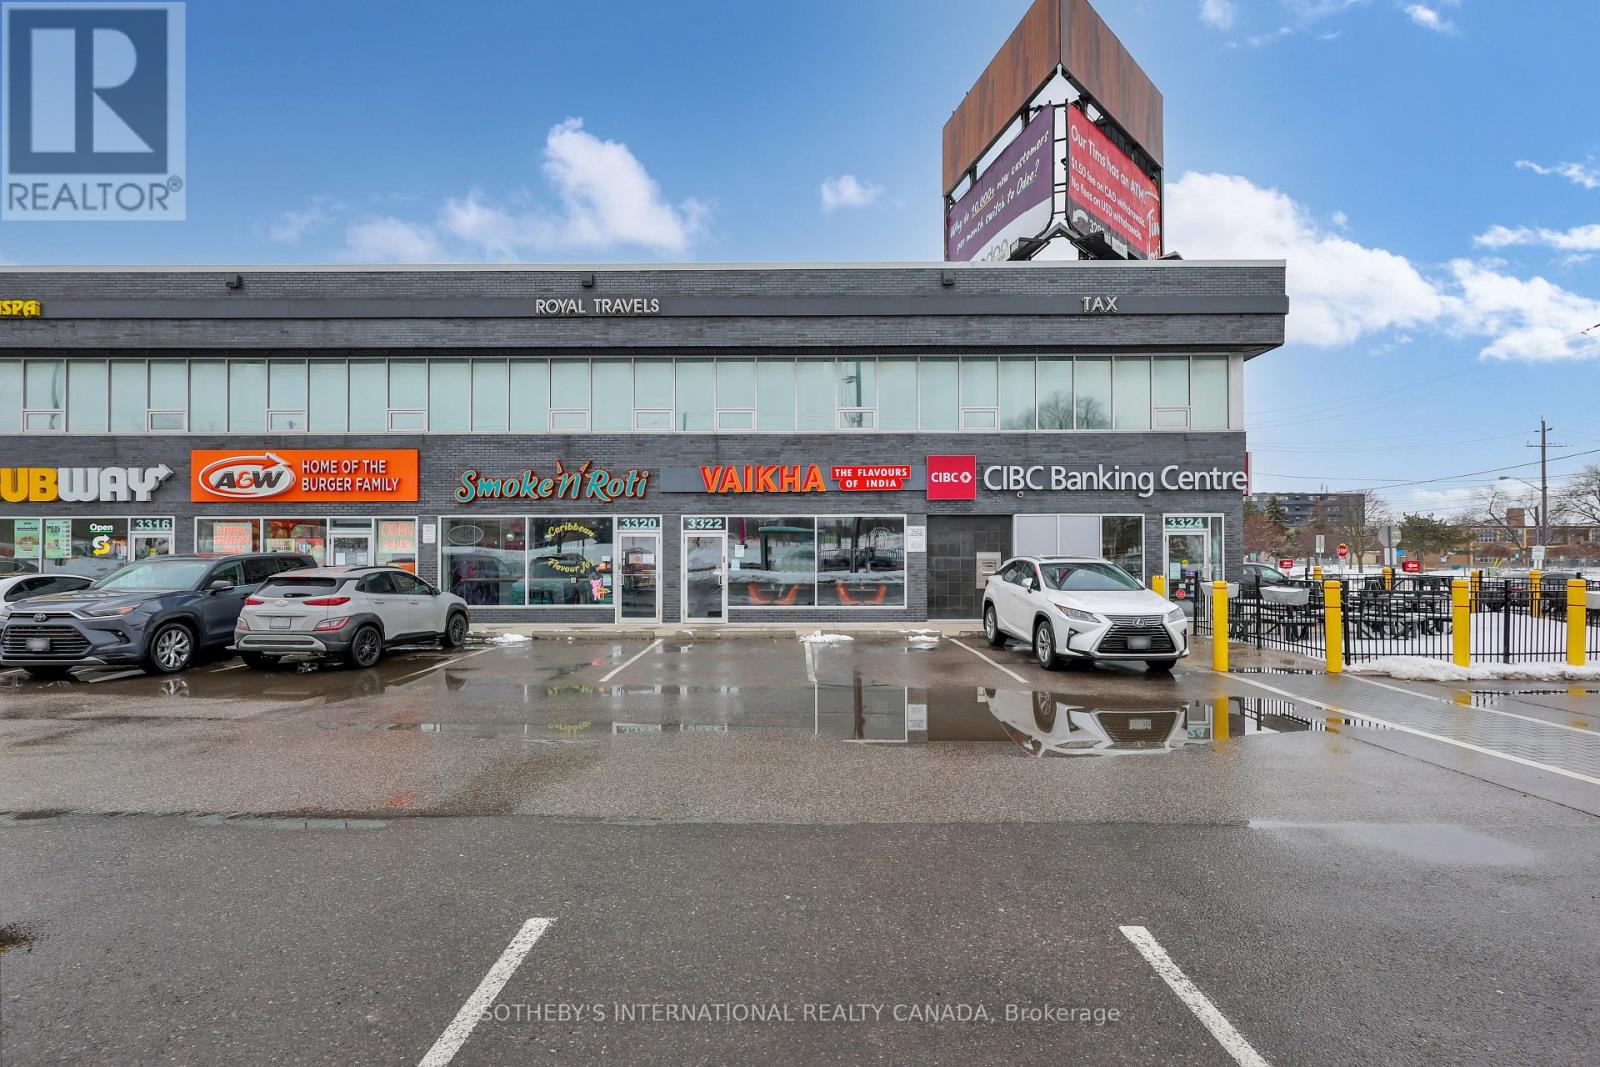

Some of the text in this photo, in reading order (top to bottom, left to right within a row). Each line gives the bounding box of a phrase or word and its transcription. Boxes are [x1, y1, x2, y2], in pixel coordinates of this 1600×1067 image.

[1011, 130, 1049, 176] customers
[1071, 124, 1087, 150] Our
[1088, 139, 1105, 168] Tims
[1106, 156, 1119, 180] has
[1121, 174, 1130, 190] an
[1007, 187, 1016, 204] to
[1071, 175, 1080, 192] No
[1093, 196, 1101, 209] on
[1101, 200, 1113, 217] USD
[0, 299, 41, 316] SPA
[535, 298, 661, 314] ROYAL TRAVELS
[1081, 296, 1118, 312] TAX
[301, 459, 386, 475] HOME OF THE
[834, 468, 908, 478] THE FLAVOURS
[0, 464, 174, 502] UBWAY
[214, 470, 284, 489] A&W
[301, 477, 400, 492] BURGER FAMILY
[700, 464, 826, 493] VAIKHA
[845, 479, 897, 488] OF INDIA
[930, 471, 960, 483] CIBC
[983, 464, 1249, 497] CIBC Banking Centre
[89, 523, 114, 532] Open
[135, 518, 171, 530] 3316
[548, 522, 595, 537] Caribbean
[621, 518, 657, 529] 3320
[687, 518, 723, 530] 3322
[1167, 517, 1204, 528] 3324
